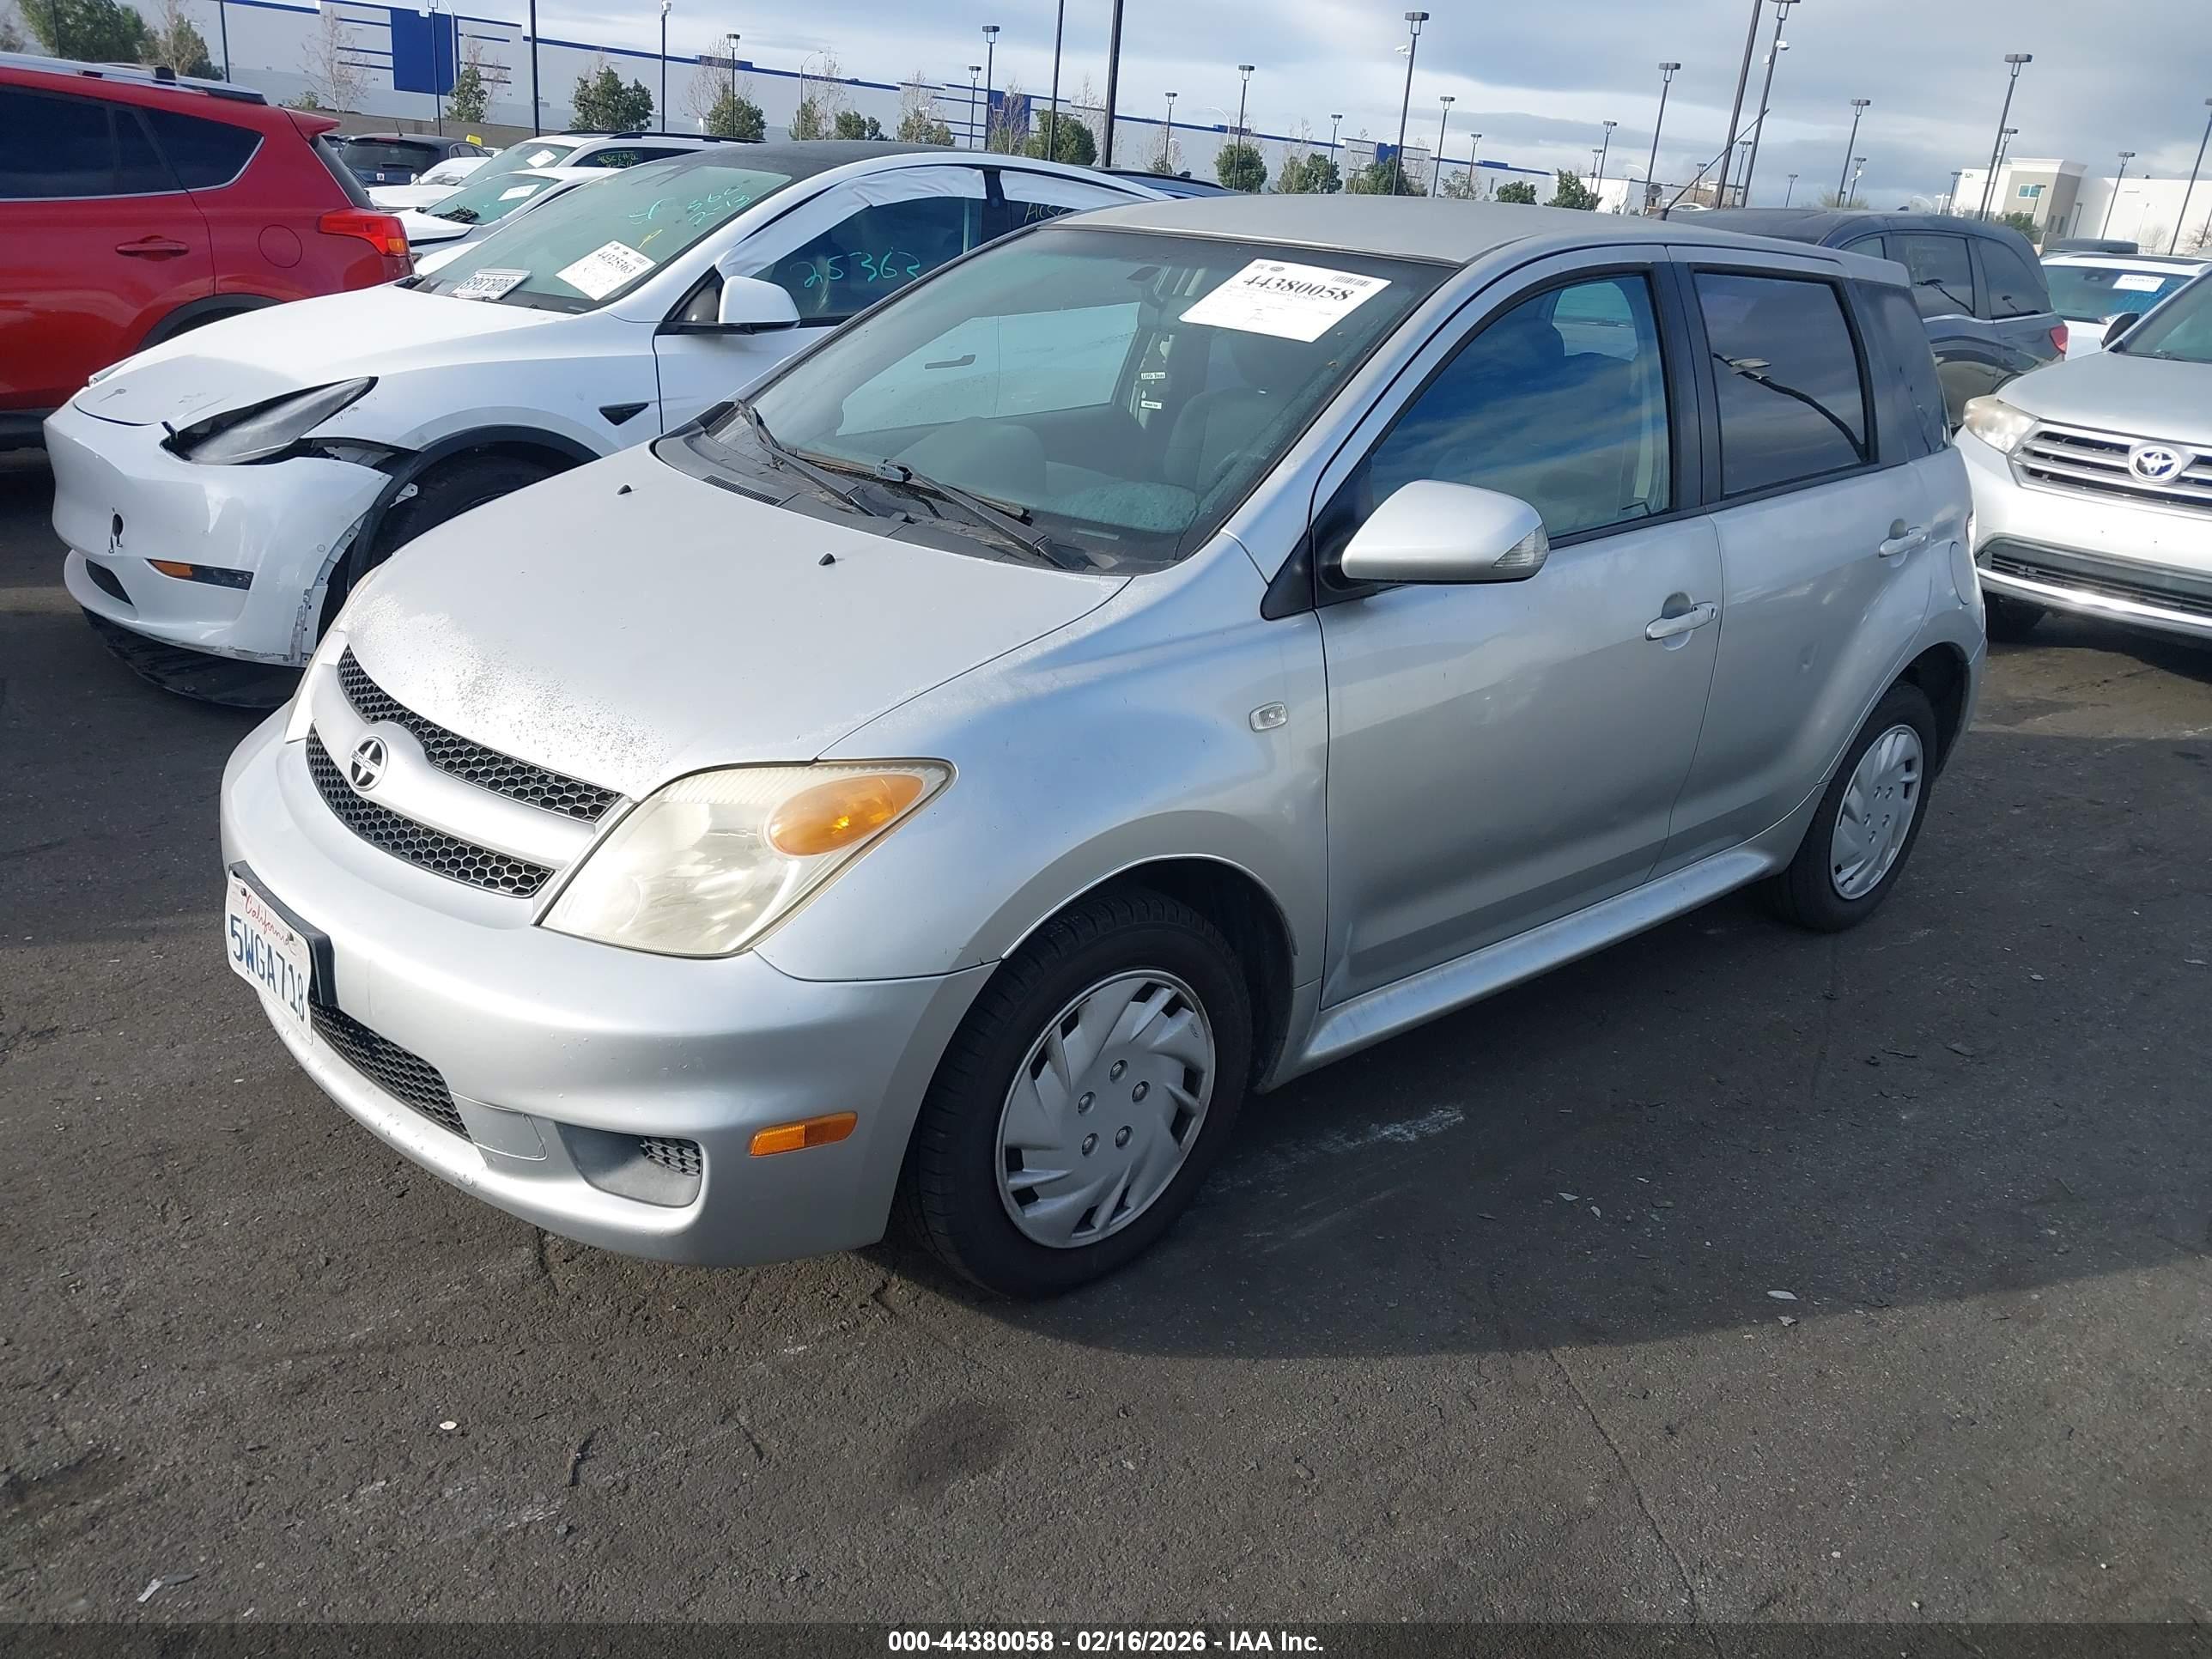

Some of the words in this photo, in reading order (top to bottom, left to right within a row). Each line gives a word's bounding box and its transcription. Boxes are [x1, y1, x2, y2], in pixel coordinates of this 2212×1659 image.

[1243, 275, 1355, 301] 44380058
[245, 894, 295, 953] California
[230, 913, 305, 1023] 5WGA718
